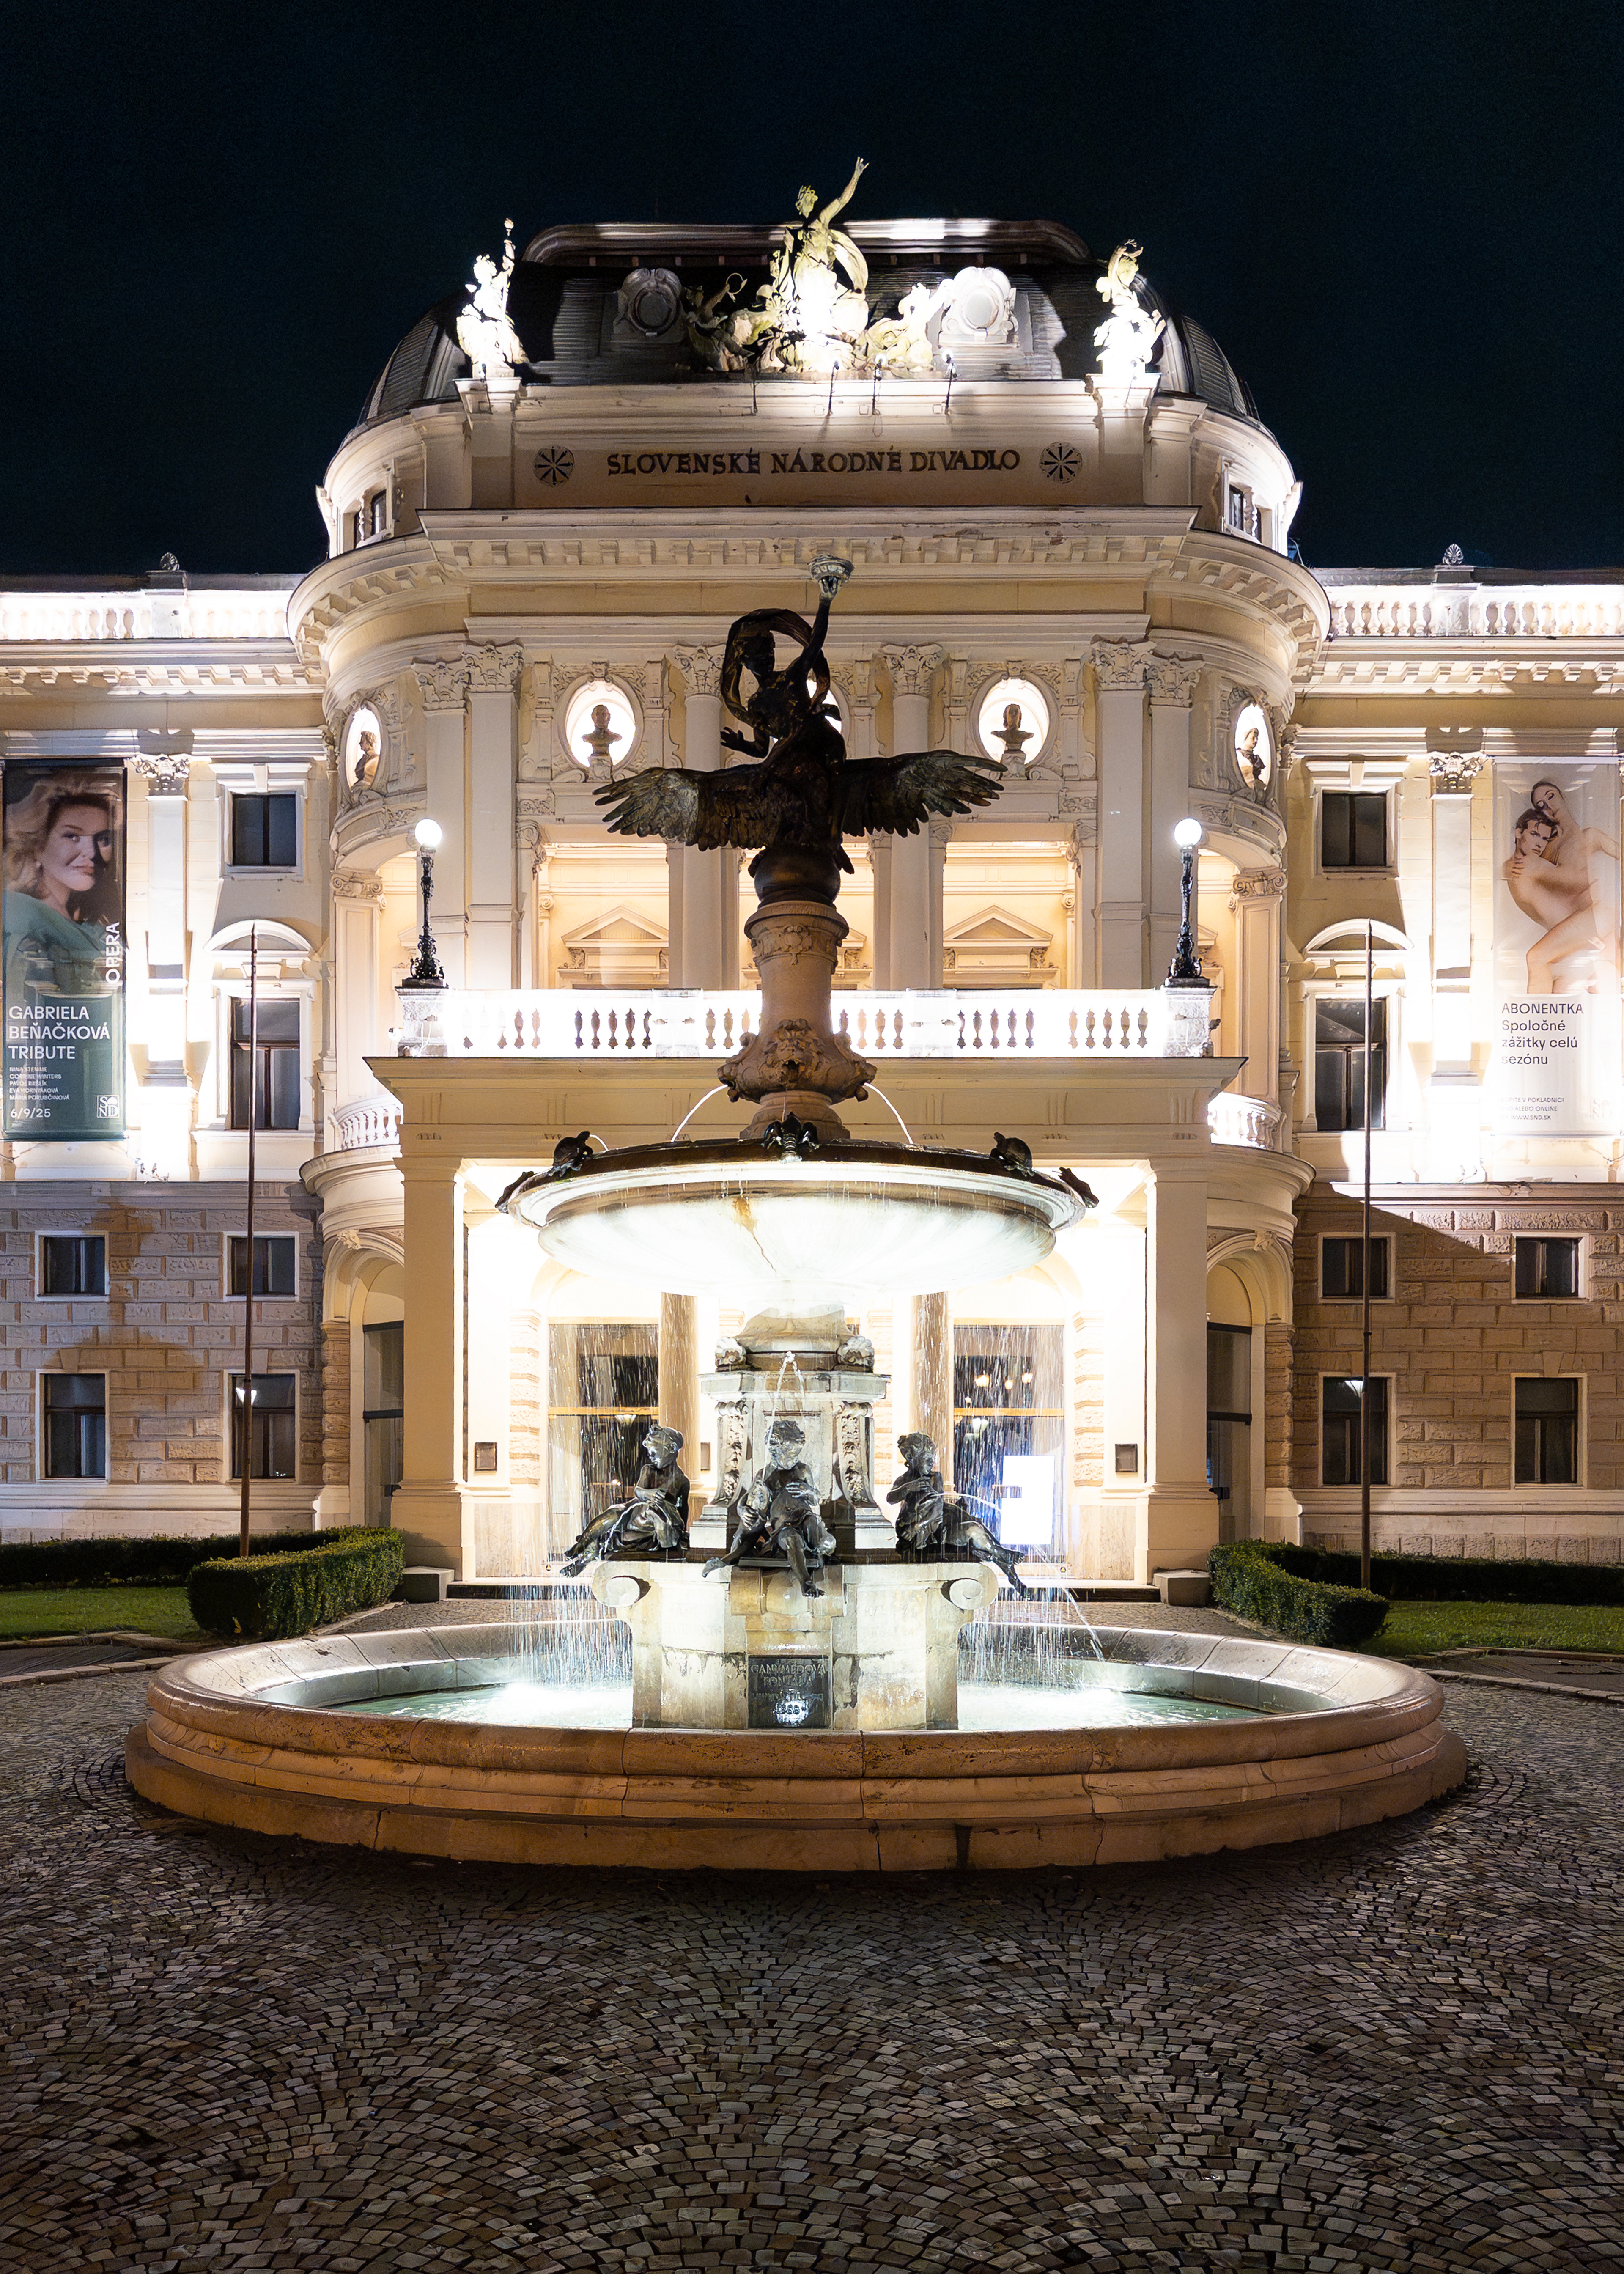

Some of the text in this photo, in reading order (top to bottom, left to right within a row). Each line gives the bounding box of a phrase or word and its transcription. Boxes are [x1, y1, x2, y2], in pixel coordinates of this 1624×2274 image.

[607, 445, 1020, 476] SLOVENSKÉ NÁRODNÉ DIVADLO
[106, 922, 120, 984] OPERA
[8, 1006, 90, 1020] GABRIELA
[1502, 1003, 1584, 1014] ABONENTKA
[9, 1022, 110, 1040] BEŇAČKOVÁ
[1502, 1019, 1566, 1034] Spoločné
[1502, 1036, 1577, 1051] zážitky celú
[8, 1046, 76, 1060] TRIBUTE
[1502, 1053, 1548, 1065] sezónu
[10, 1107, 51, 1119] 6/9/25
